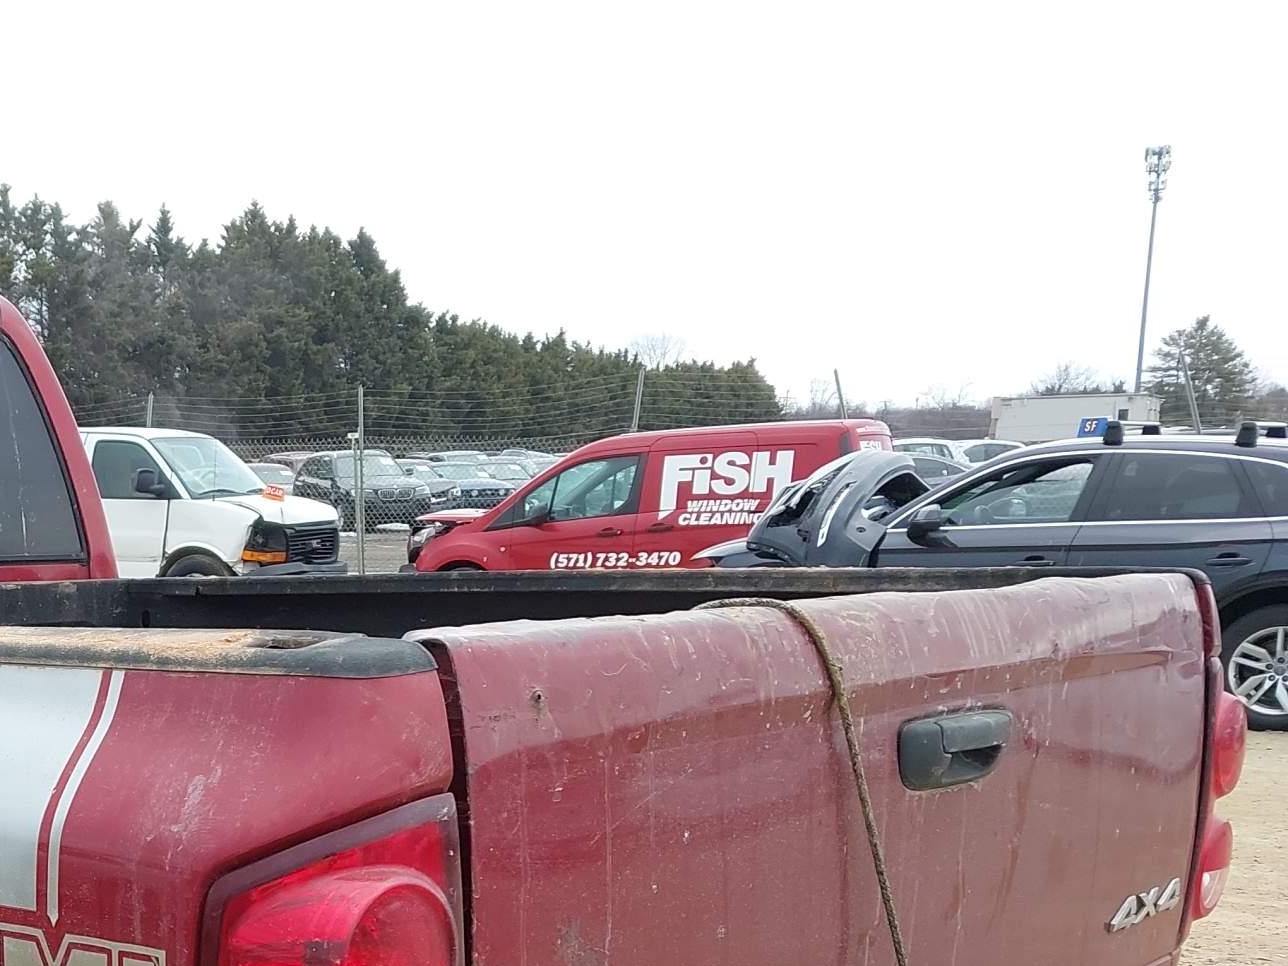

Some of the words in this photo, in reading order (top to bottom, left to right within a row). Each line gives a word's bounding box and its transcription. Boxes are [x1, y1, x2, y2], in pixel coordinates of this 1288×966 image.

[1084, 420, 1099, 432] SF
[687, 498, 760, 512] WINDOW
[550, 551, 592, 569] (571)
[595, 551, 681, 567] 732-3470
